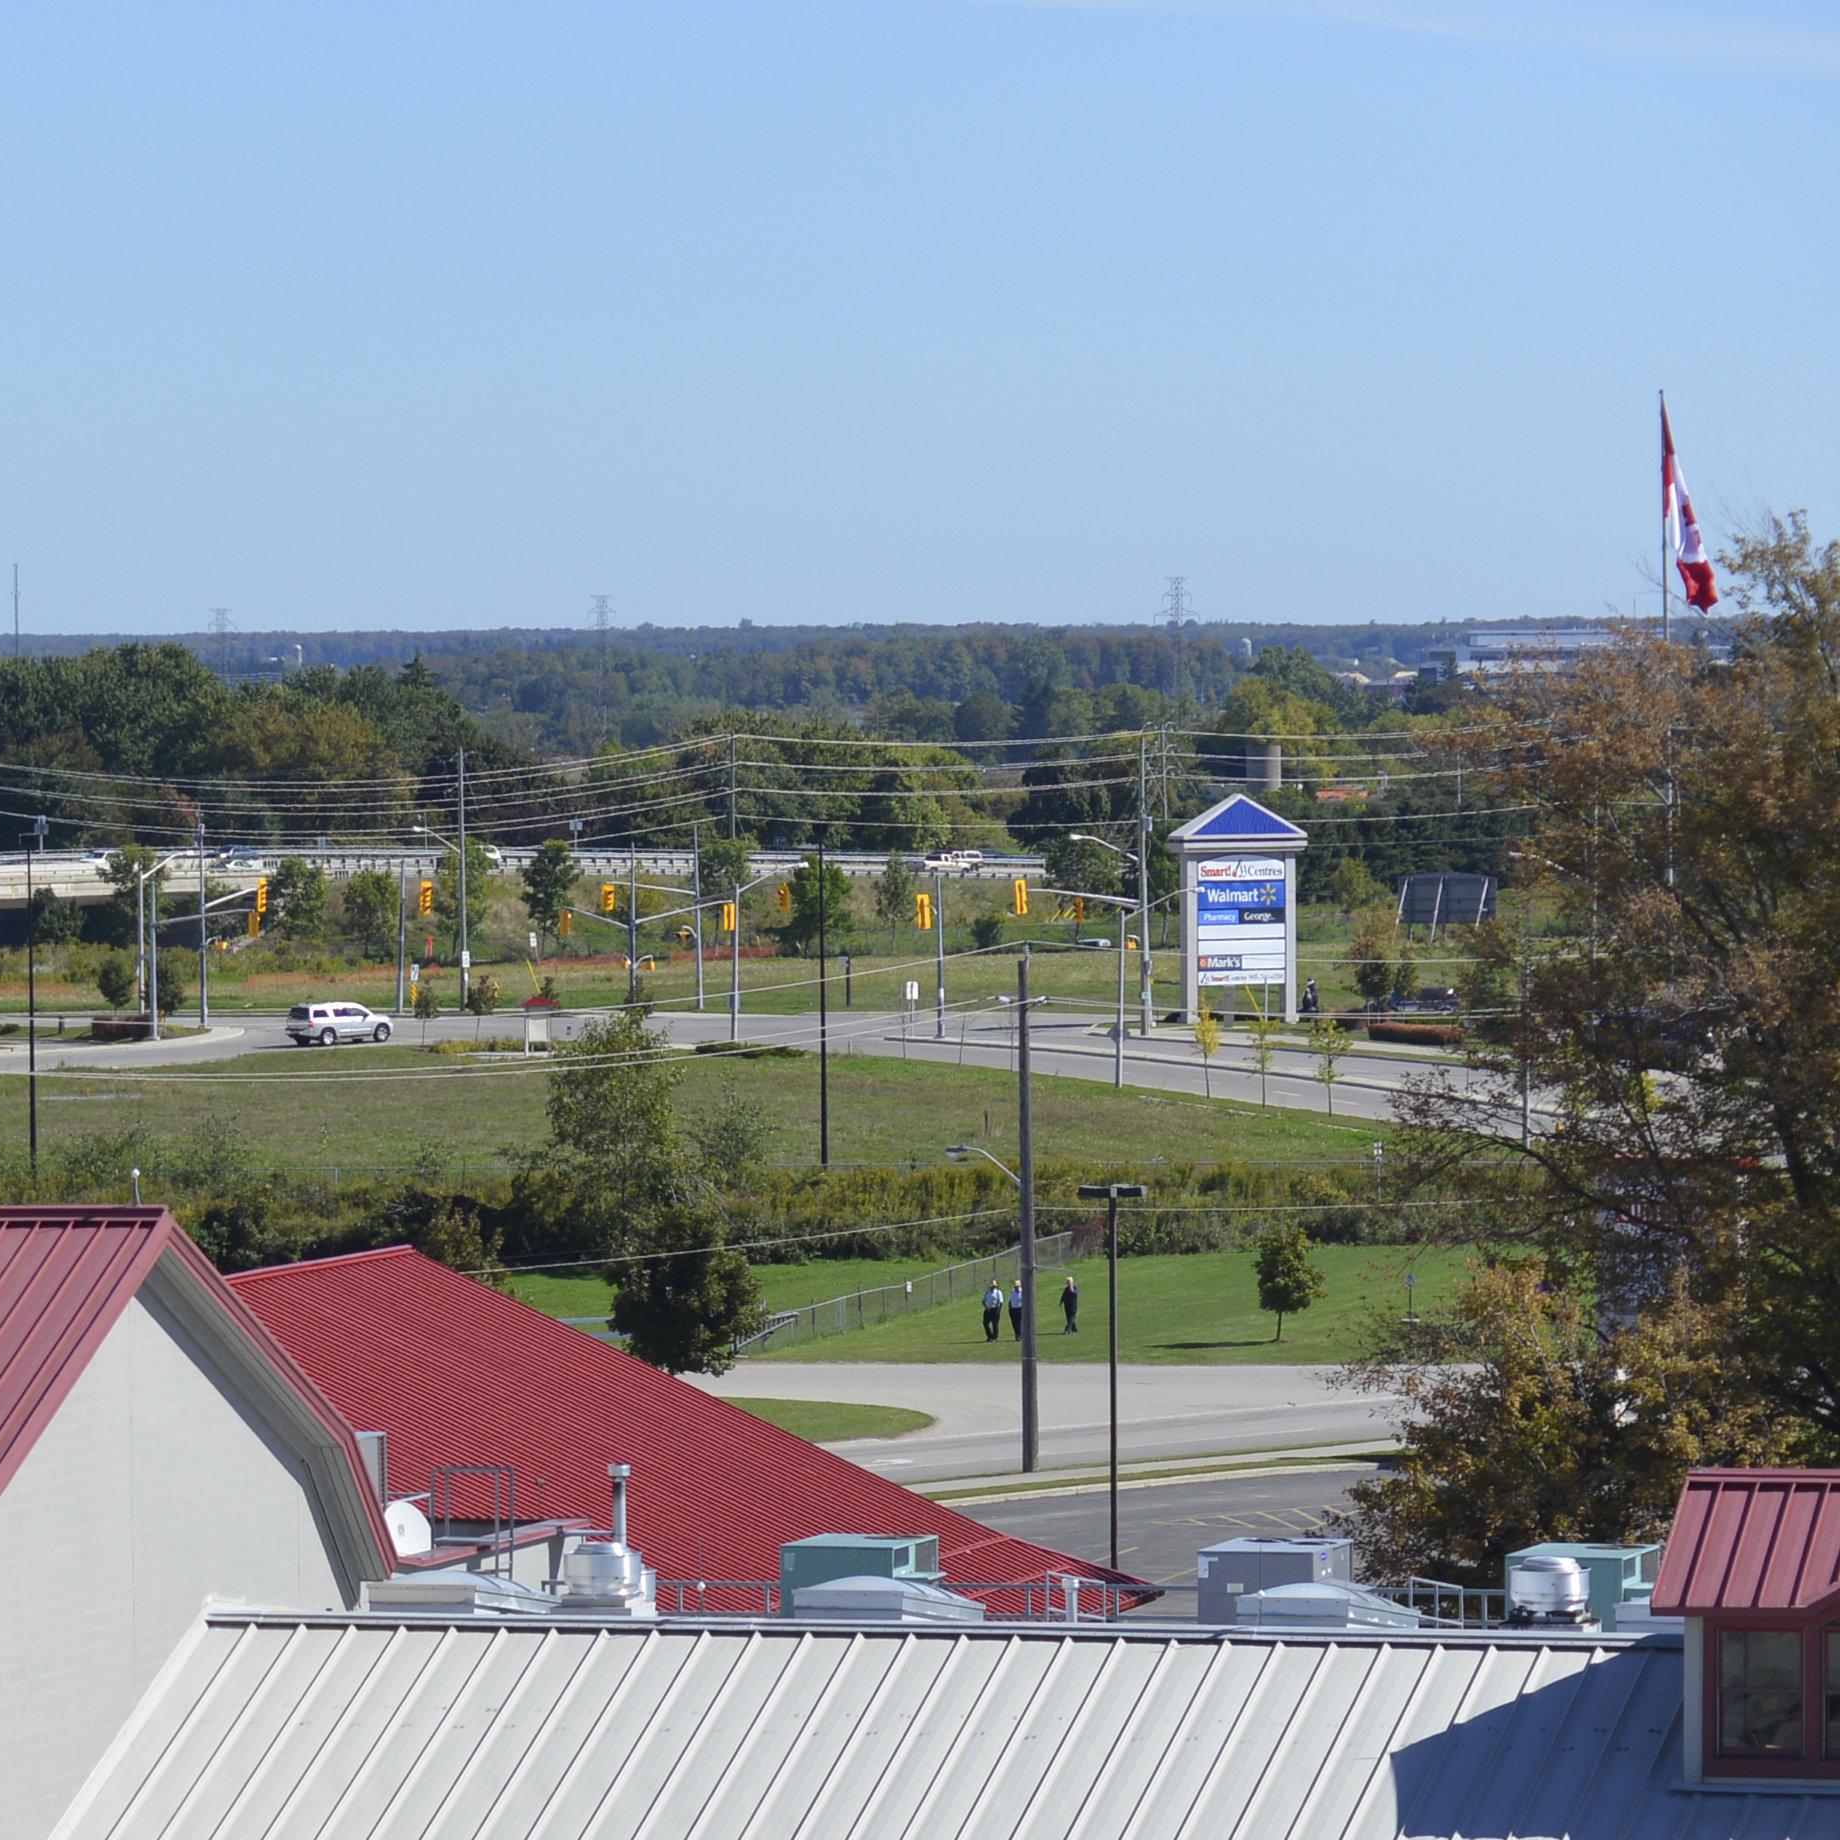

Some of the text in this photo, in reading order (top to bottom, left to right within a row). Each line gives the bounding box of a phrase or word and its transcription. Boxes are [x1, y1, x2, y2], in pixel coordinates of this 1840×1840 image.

[1207, 888, 1259, 903] Walmart
[1203, 911, 1236, 922] Pharmacy
[1208, 956, 1241, 968] Mark's
